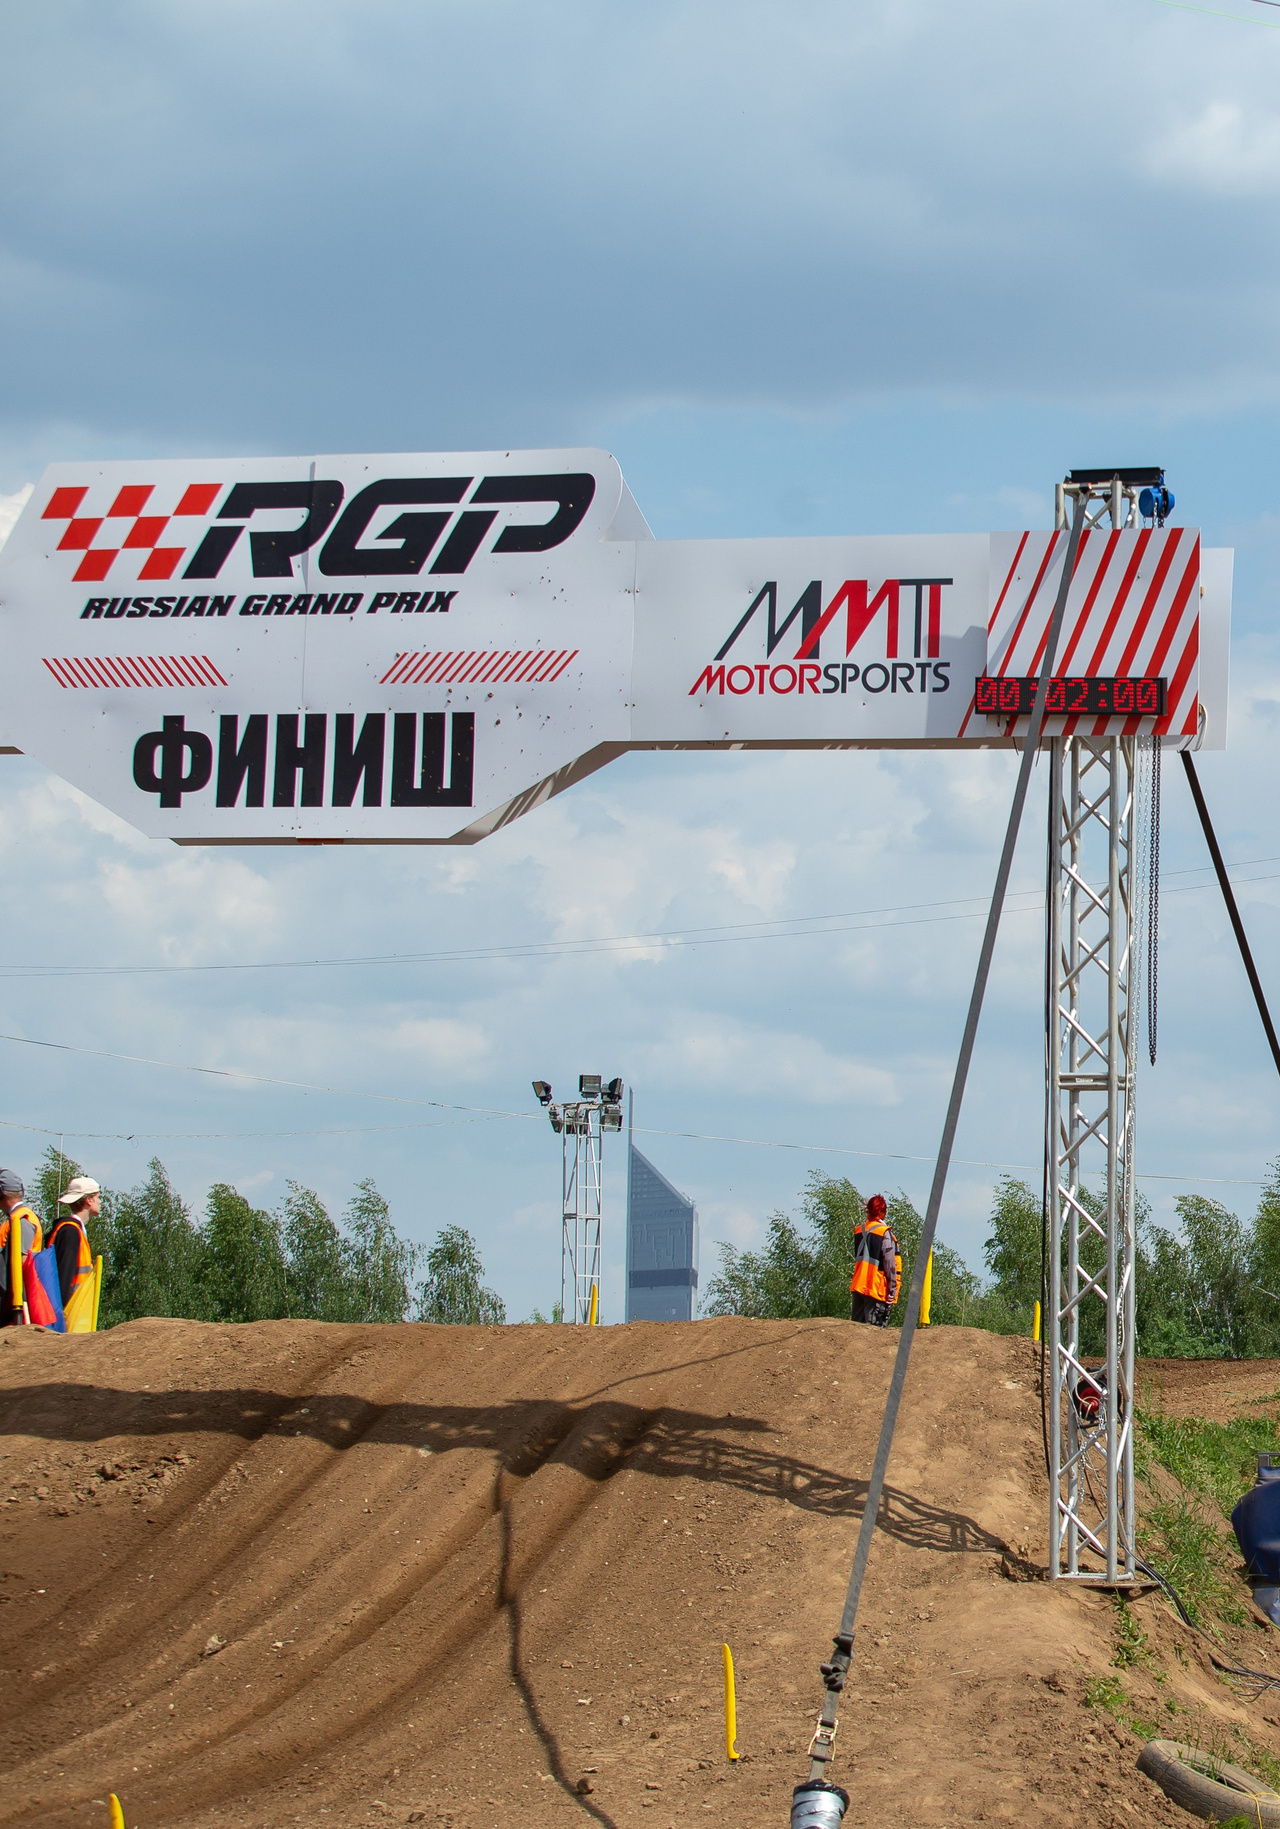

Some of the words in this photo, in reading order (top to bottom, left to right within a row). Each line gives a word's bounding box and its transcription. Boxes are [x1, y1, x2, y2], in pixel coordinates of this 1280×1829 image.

[181, 473, 596, 580] RGP
[80, 594, 237, 619] RUSSIAN
[238, 592, 364, 616] GRAND
[366, 591, 460, 614] PRIX
[688, 662, 951, 696] MOTORSPORTS
[132, 711, 476, 809] ФИНИШ
